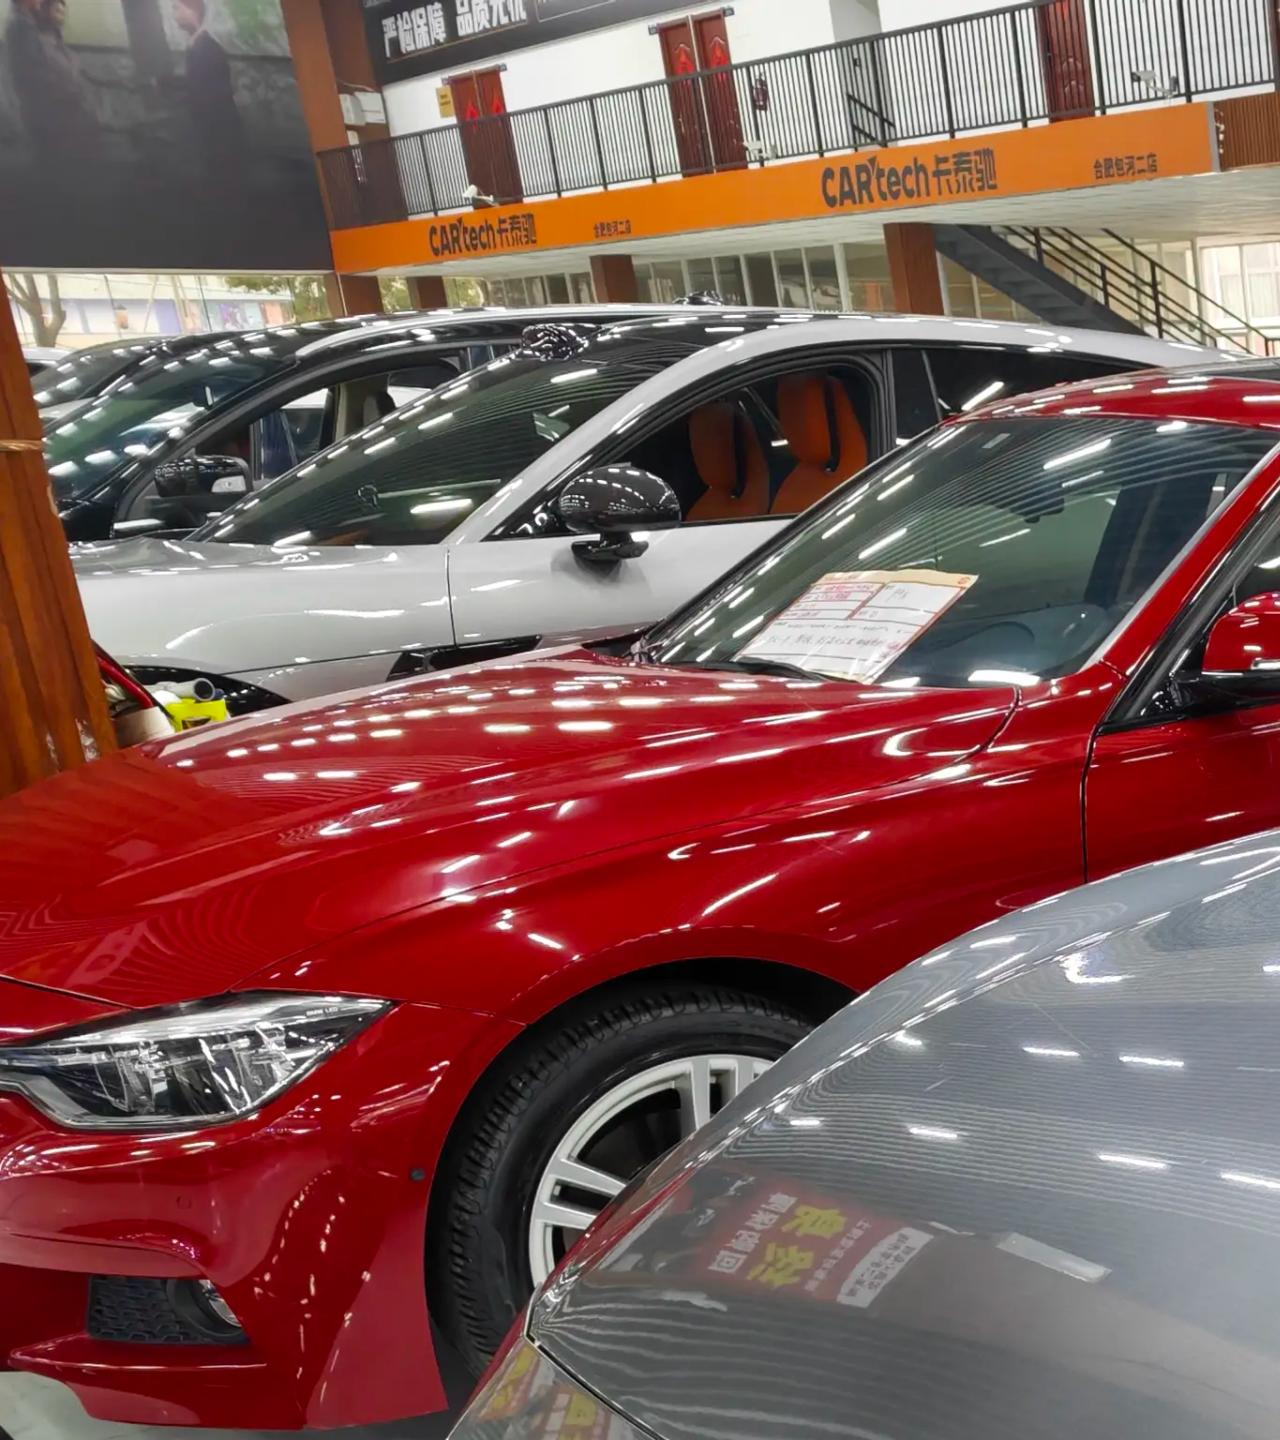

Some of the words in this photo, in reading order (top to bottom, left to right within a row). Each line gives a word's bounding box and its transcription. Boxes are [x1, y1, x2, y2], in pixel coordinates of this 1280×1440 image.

[382, 2, 447, 57] 严检保障
[932, 148, 997, 195] 卡泰驰
[1094, 153, 1158, 180] 合肥包河二店
[498, 213, 537, 249] 卡泰驰
